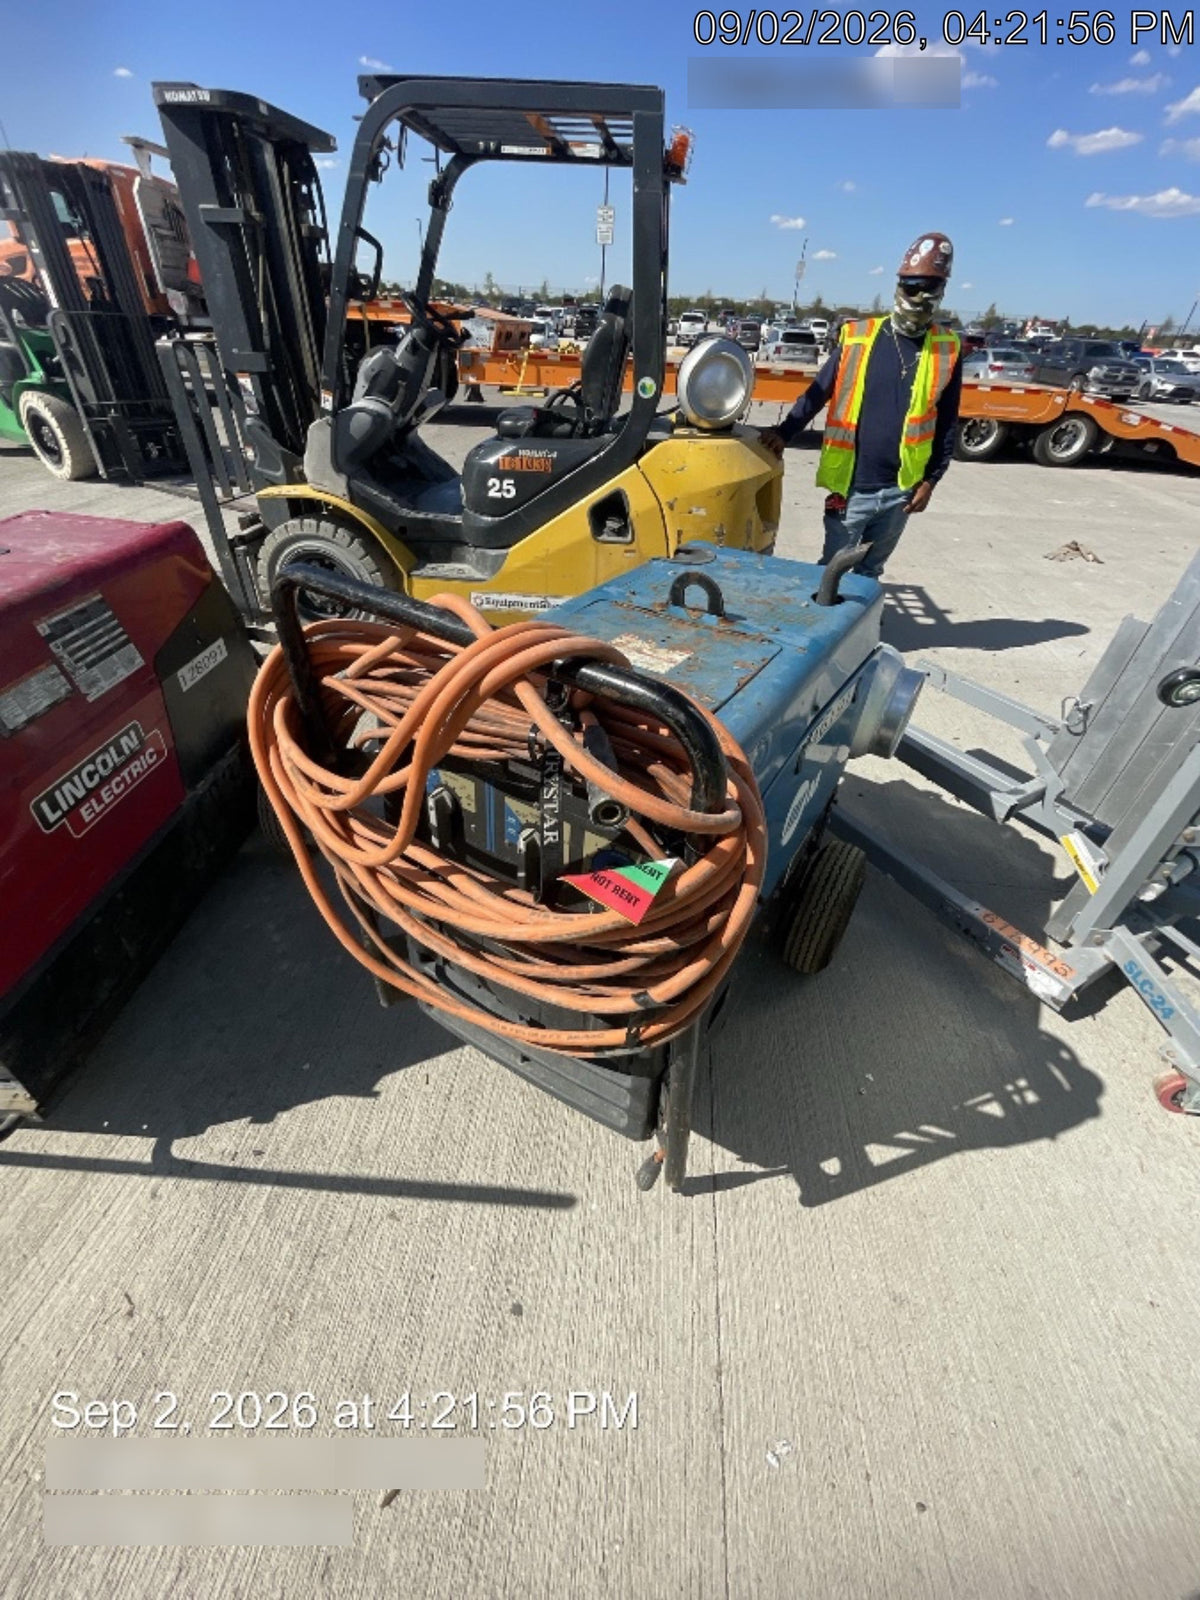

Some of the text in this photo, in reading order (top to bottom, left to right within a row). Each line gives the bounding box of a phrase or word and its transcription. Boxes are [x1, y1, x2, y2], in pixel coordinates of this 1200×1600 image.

[486, 477, 517, 499] 25
[40, 729, 140, 824] LINCOLN
[79, 747, 158, 823] ELECTRIC
[611, 883, 641, 908] RENT
[1123, 960, 1175, 1020] SLC-24
